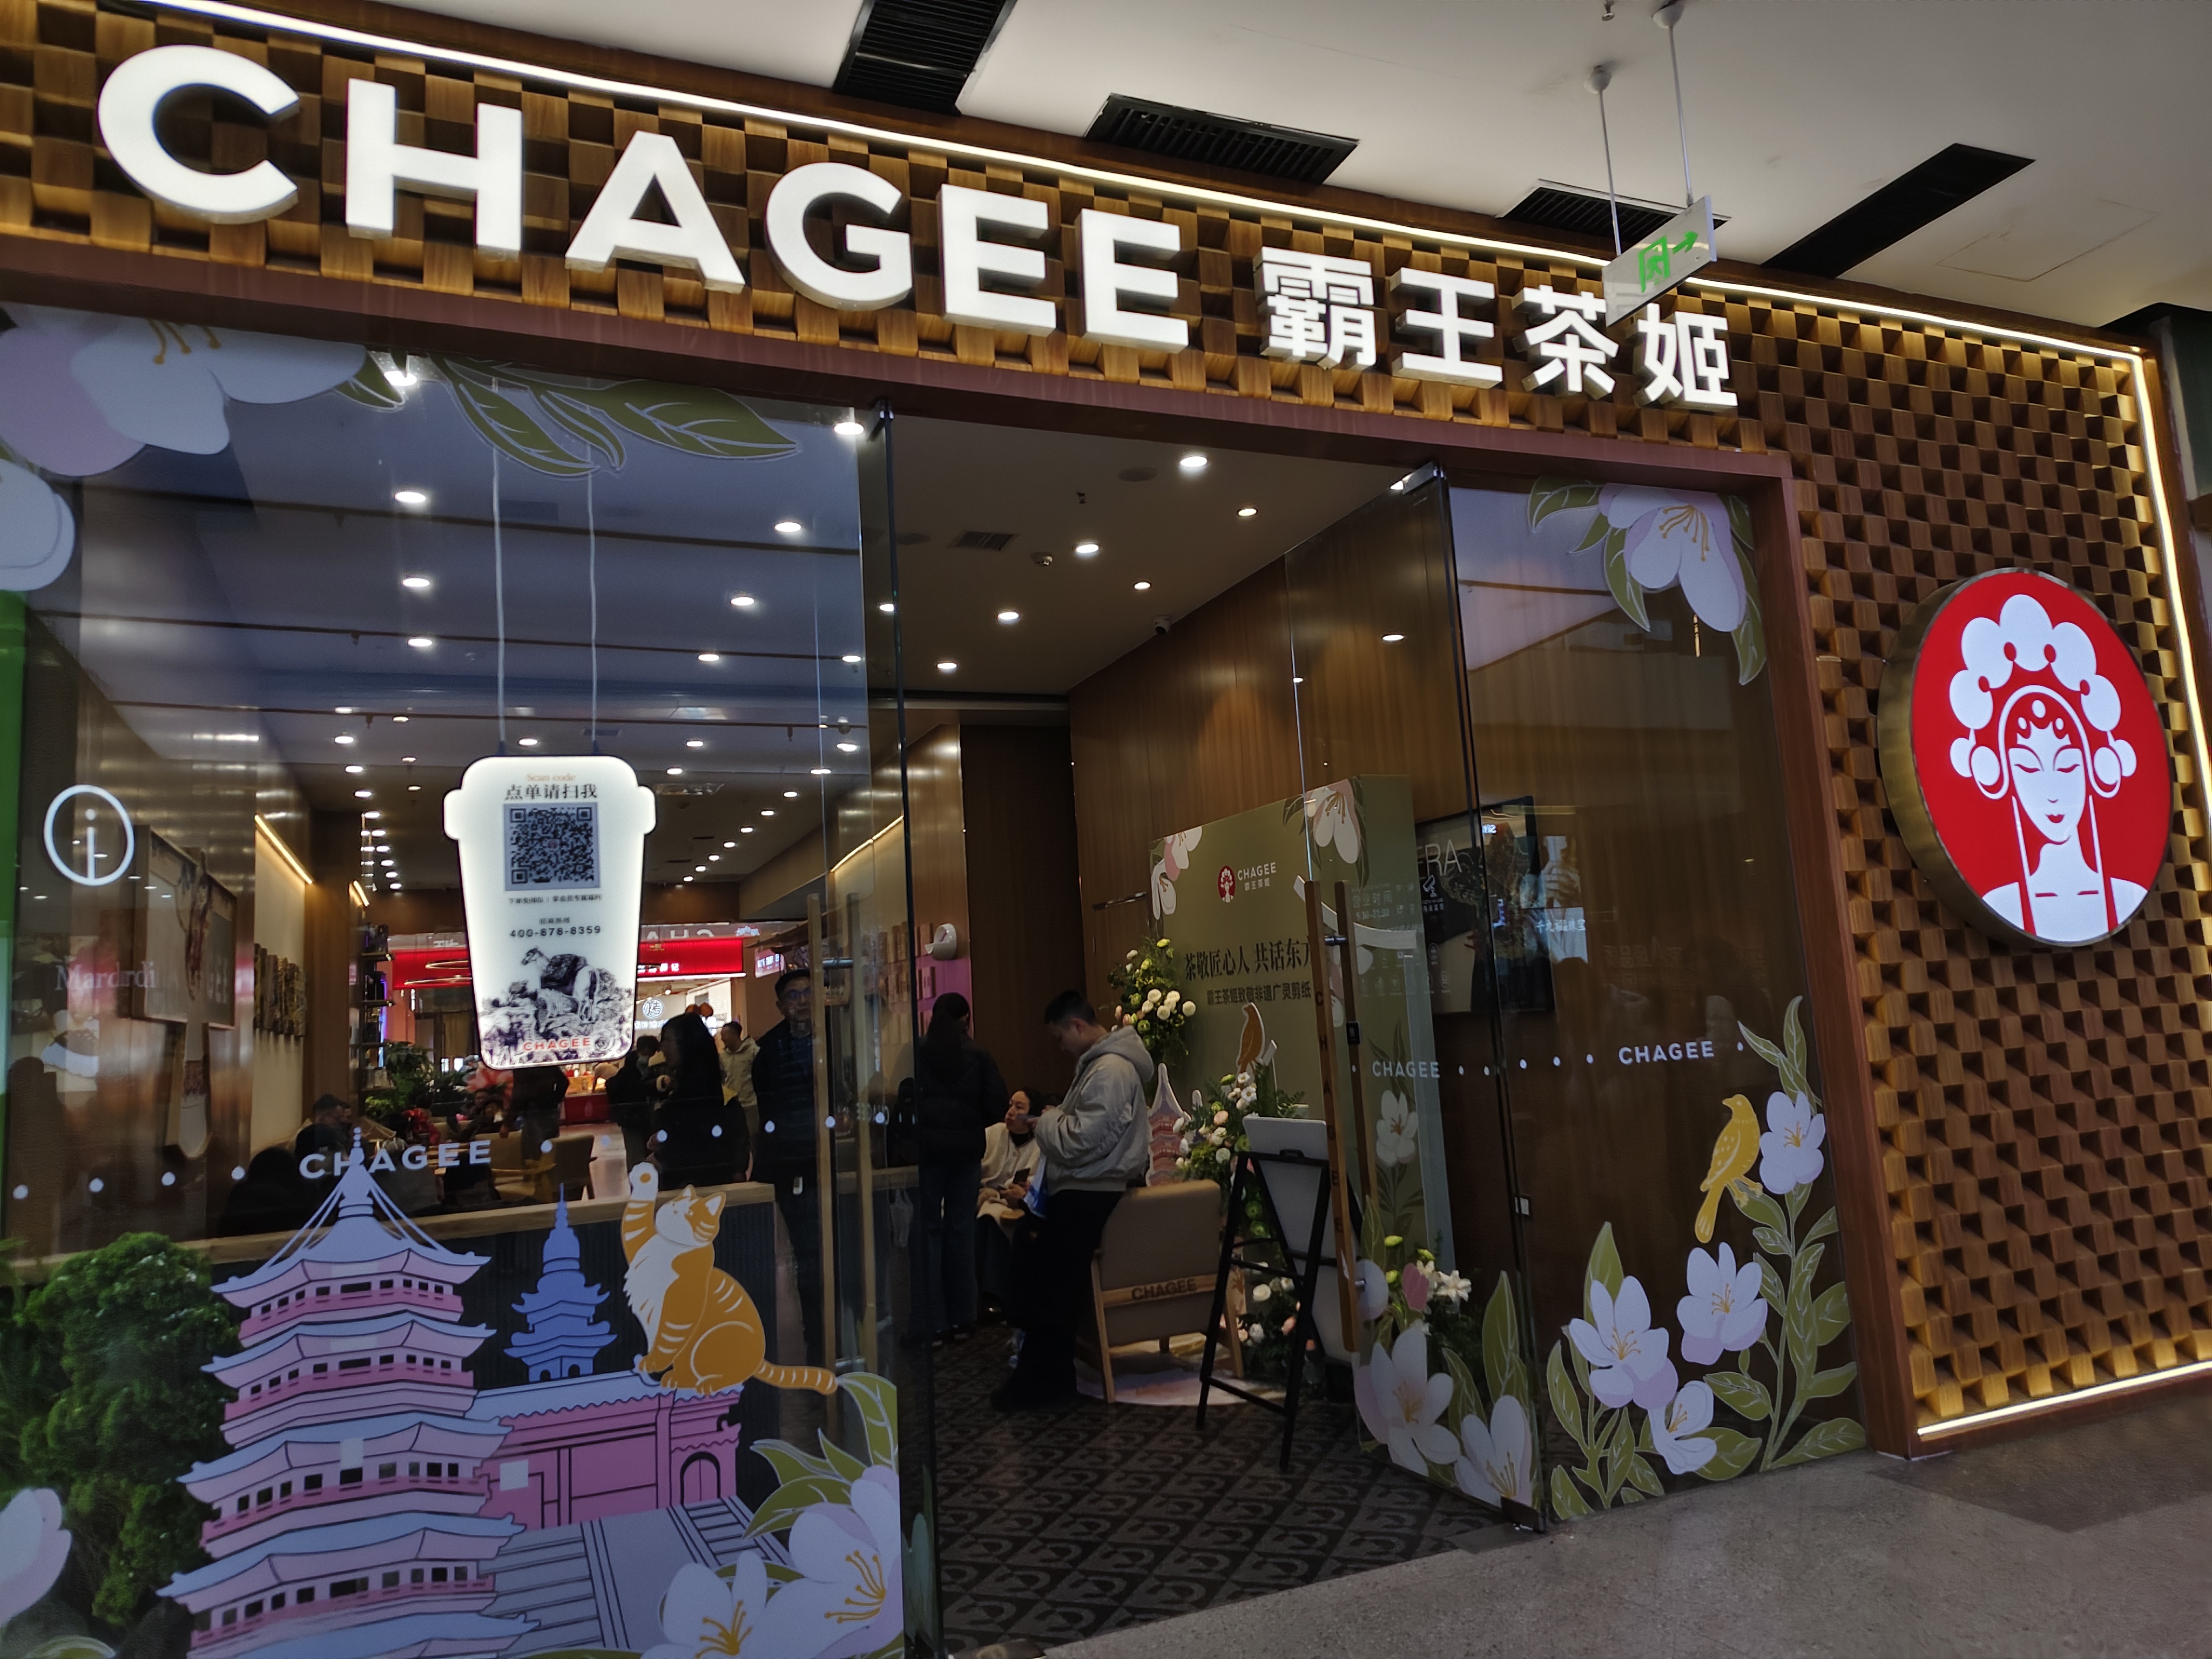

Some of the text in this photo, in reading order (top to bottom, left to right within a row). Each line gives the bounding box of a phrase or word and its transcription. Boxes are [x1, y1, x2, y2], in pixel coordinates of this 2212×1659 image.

[98, 44, 1739, 408] CHAGEE 霸王茶姬
[526, 773, 576, 781] Scan code
[504, 783, 598, 800] 点单请扫我
[1237, 861, 1277, 881] CHAGEE
[509, 925, 601, 938] 400-878-8359
[1184, 946, 1250, 982] 茶敬匠心人
[522, 1036, 591, 1052] CHAGEE
[1618, 1040, 1715, 1065] CHAGEE
[1372, 1061, 1440, 1078] CHAGEE
[1131, 1278, 1197, 1300] CHAGEE
